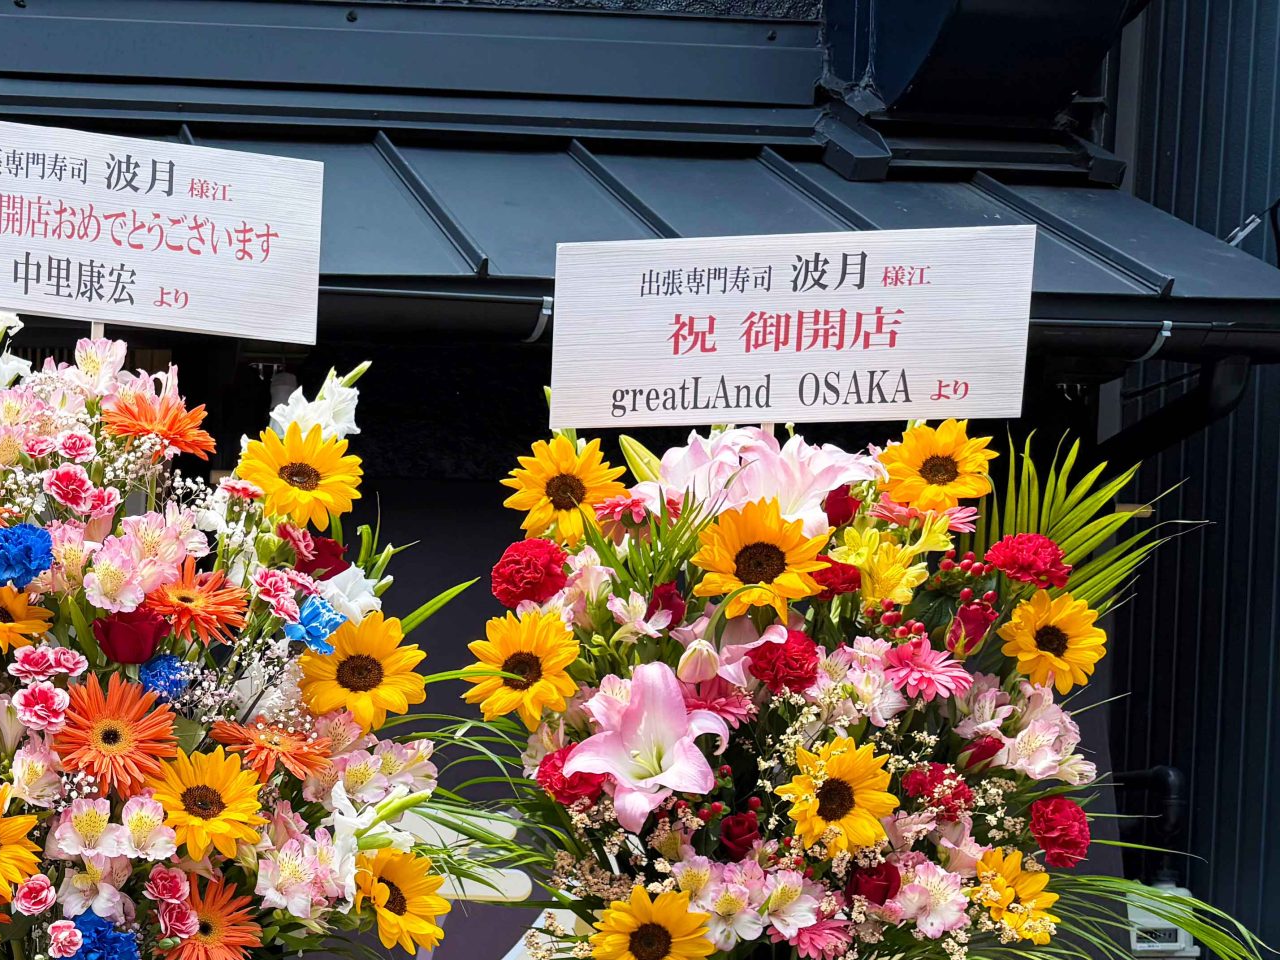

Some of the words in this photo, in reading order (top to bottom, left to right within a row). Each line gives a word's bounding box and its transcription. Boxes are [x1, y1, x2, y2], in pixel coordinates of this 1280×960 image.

[104, 152, 175, 197] 波月
[187, 178, 233, 202] 様江
[13, 250, 137, 306] 中里康宏
[152, 286, 189, 309] より
[640, 265, 773, 297] 出張専門寿司
[789, 250, 868, 293] 波月
[881, 265, 932, 288] 様江
[666, 312, 718, 355] 祝
[739, 305, 906, 353] 御開店
[610, 373, 772, 418] greatLAnd
[797, 367, 913, 408] OSAKA
[929, 378, 970, 401] より
